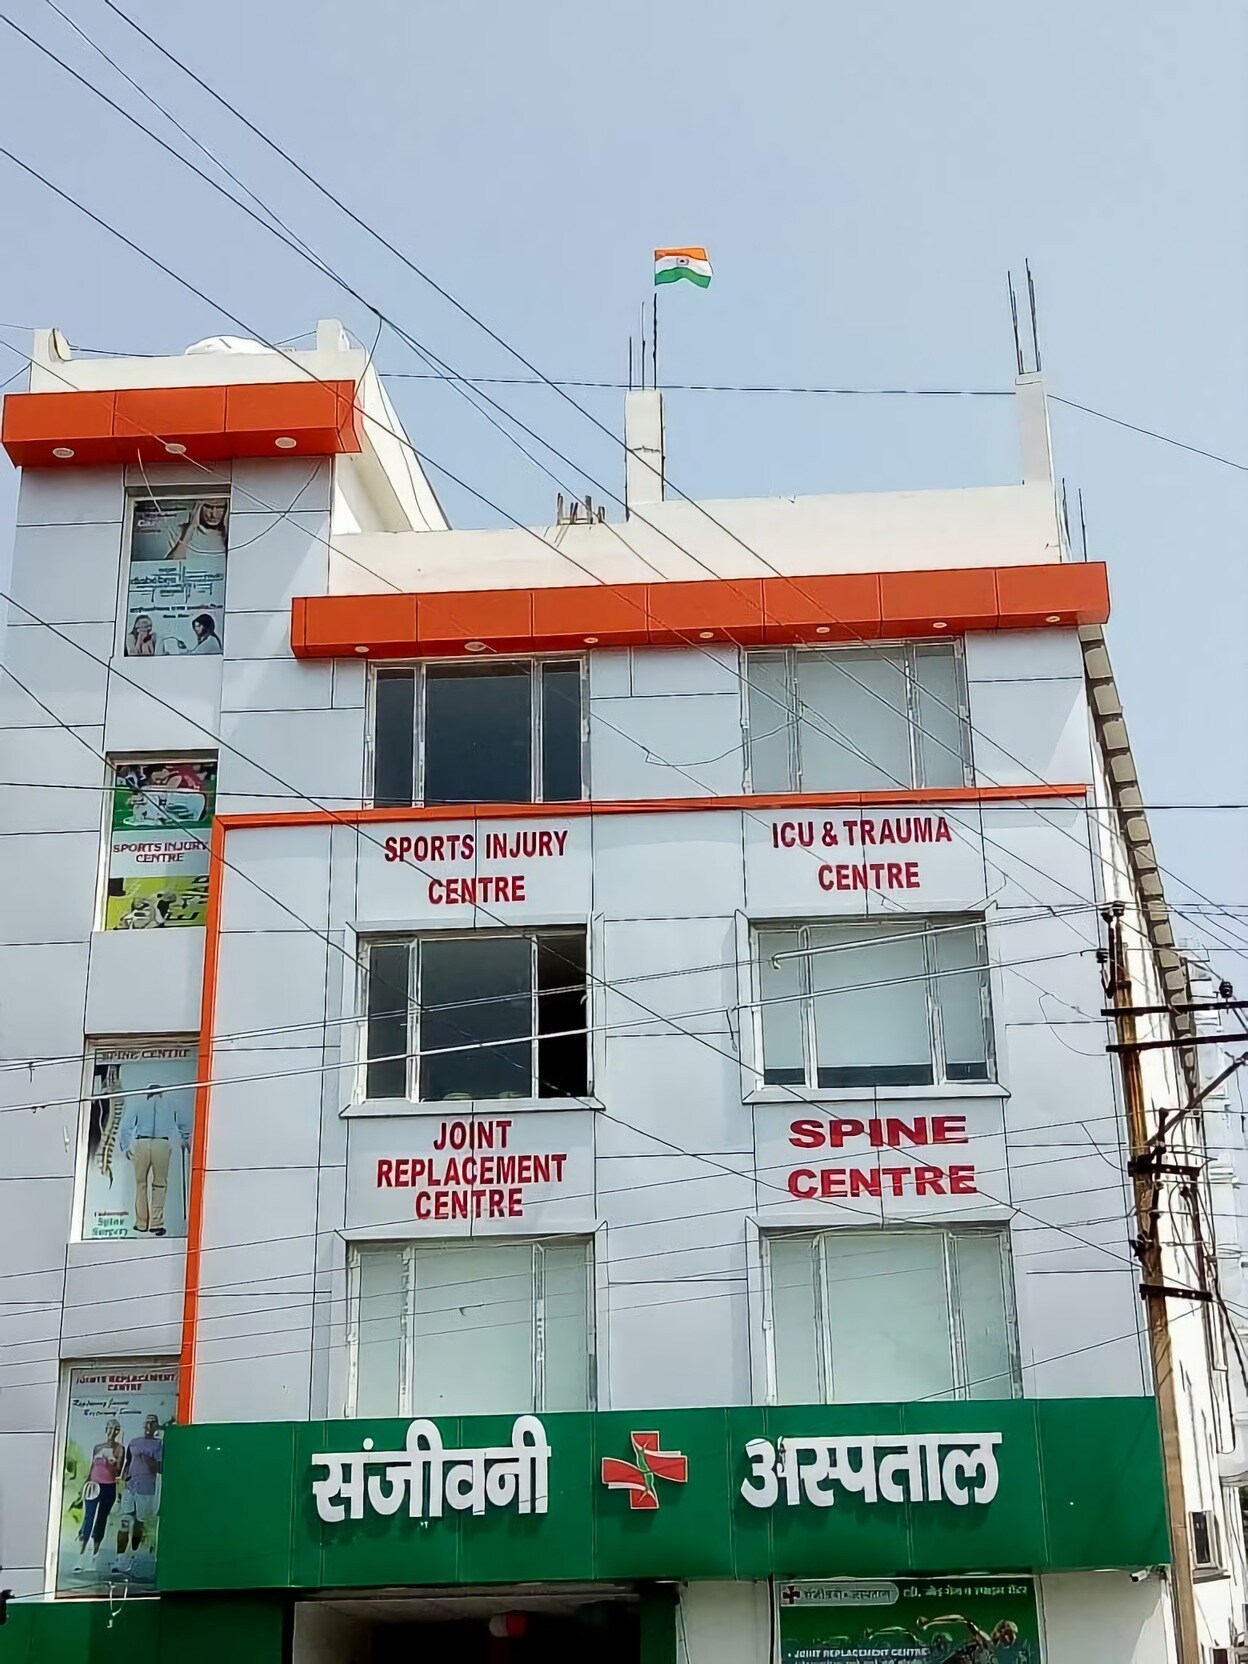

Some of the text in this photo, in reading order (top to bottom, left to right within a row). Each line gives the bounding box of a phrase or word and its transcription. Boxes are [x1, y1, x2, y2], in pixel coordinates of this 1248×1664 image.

[113, 842, 163, 853] SPORTS
[384, 830, 568, 862] SPORTS INJURY
[772, 816, 953, 849] ICU & TRAUMA
[136, 853, 184, 862] CENTRE
[428, 875, 526, 905] CENTRE
[818, 861, 921, 892] CENTRE
[433, 1120, 513, 1151] JOINT
[788, 1115, 969, 1149] SPINE
[376, 1153, 568, 1188] REPLACEMENT
[787, 1164, 978, 1200] CENTRE
[415, 1187, 524, 1220] CENTRE
[312, 1414, 1003, 1523] संजीवनी अस्पताल
